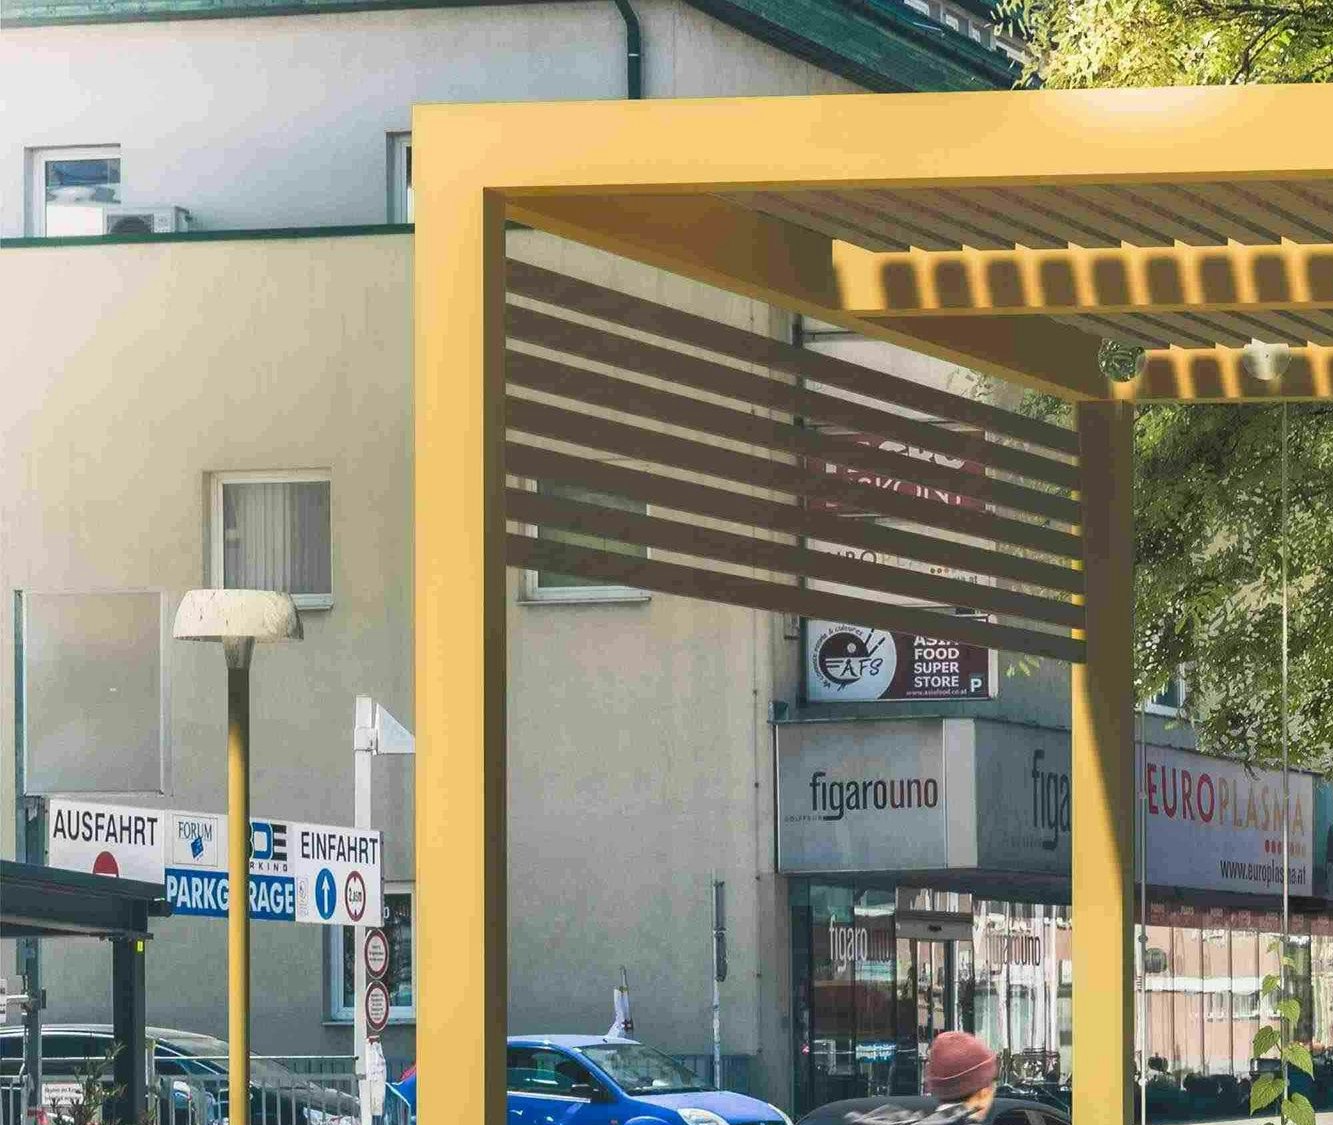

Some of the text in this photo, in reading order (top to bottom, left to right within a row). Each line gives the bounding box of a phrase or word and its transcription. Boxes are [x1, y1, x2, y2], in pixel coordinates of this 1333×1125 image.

[914, 635, 960, 646] AS
[914, 647, 960, 660] FOOD
[914, 661, 960, 674] SUPER
[914, 675, 960, 688] STORE
[970, 678, 983, 692] P
[809, 771, 939, 821] figarouno
[53, 809, 158, 846] AUSFAHRT
[178, 821, 213, 840] FORUM
[301, 831, 378, 865] EINFAHRT
[249, 861, 288, 872] RKING
[166, 874, 294, 914] PARKGRAGE
